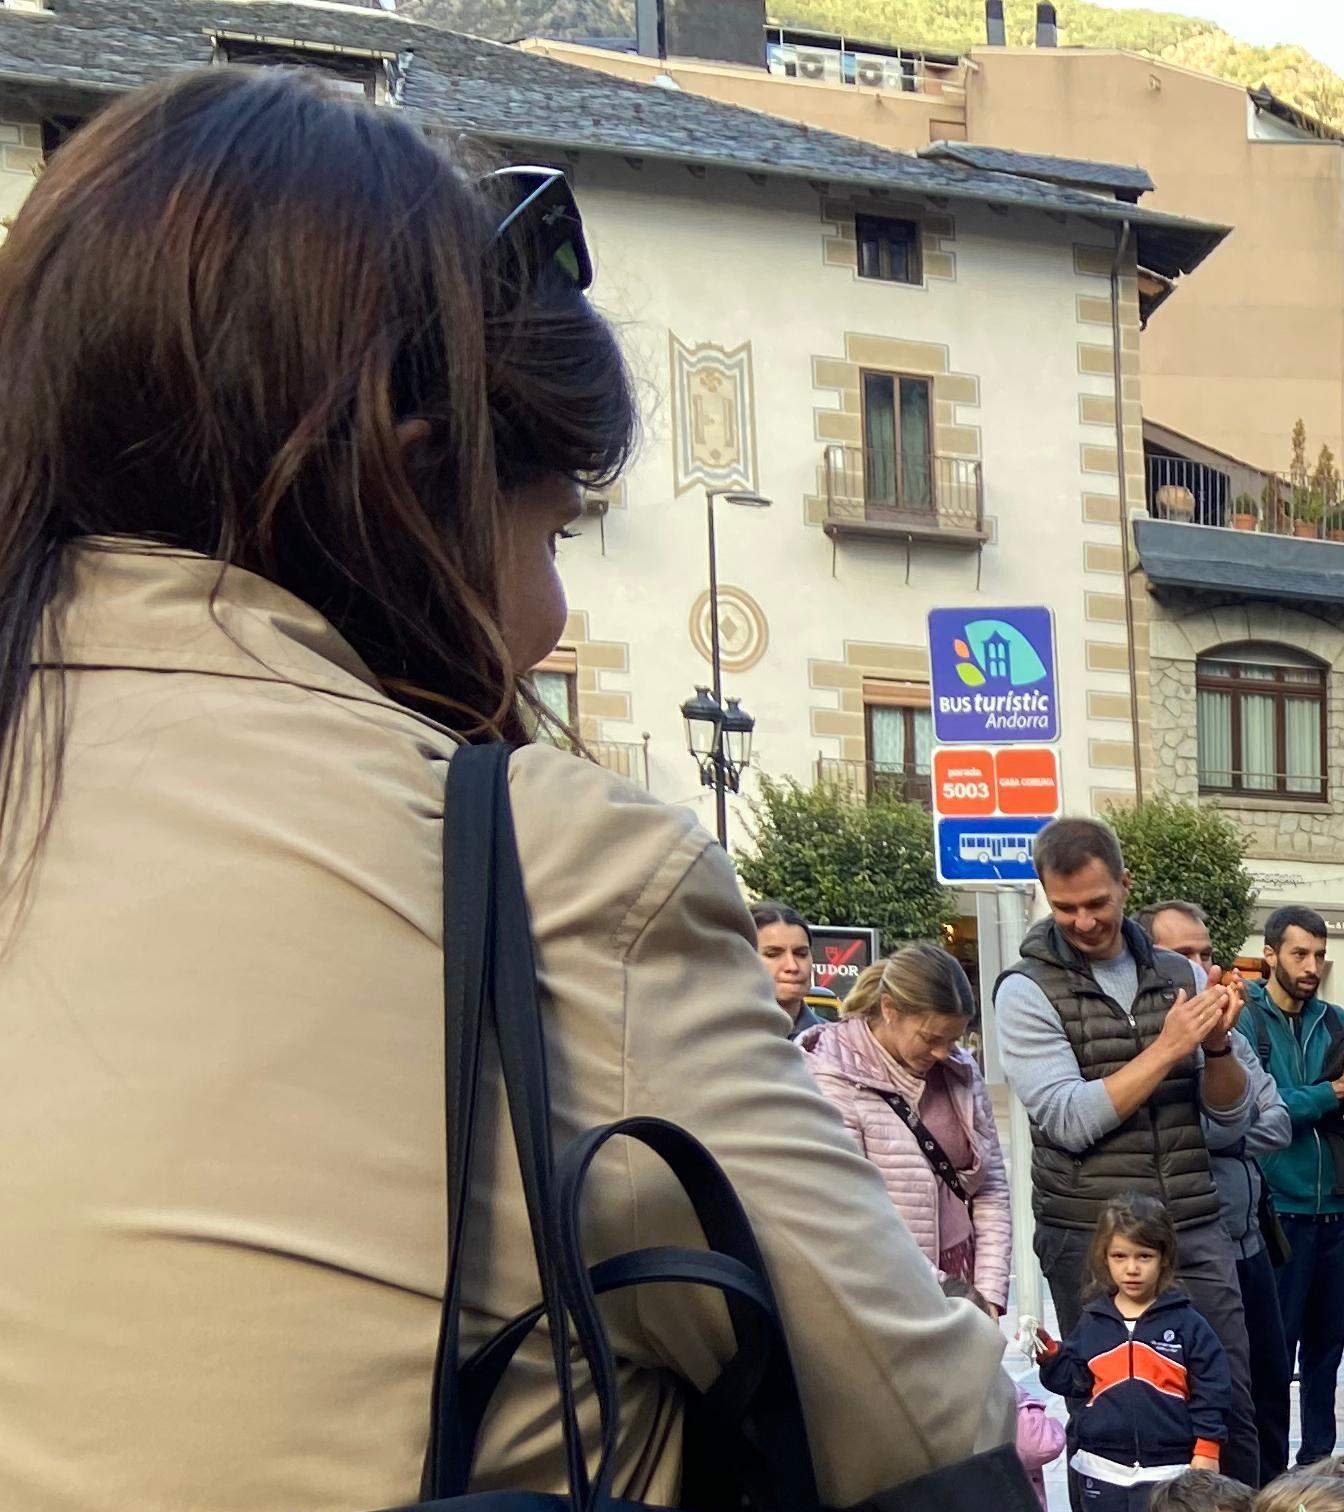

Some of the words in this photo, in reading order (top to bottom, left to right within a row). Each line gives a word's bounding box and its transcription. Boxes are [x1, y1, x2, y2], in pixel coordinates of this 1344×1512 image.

[940, 696, 972, 714] BUS
[974, 689, 1049, 713] turístic
[985, 712, 1049, 730] Andorra
[947, 767, 983, 779] parada
[943, 782, 990, 799] 5003
